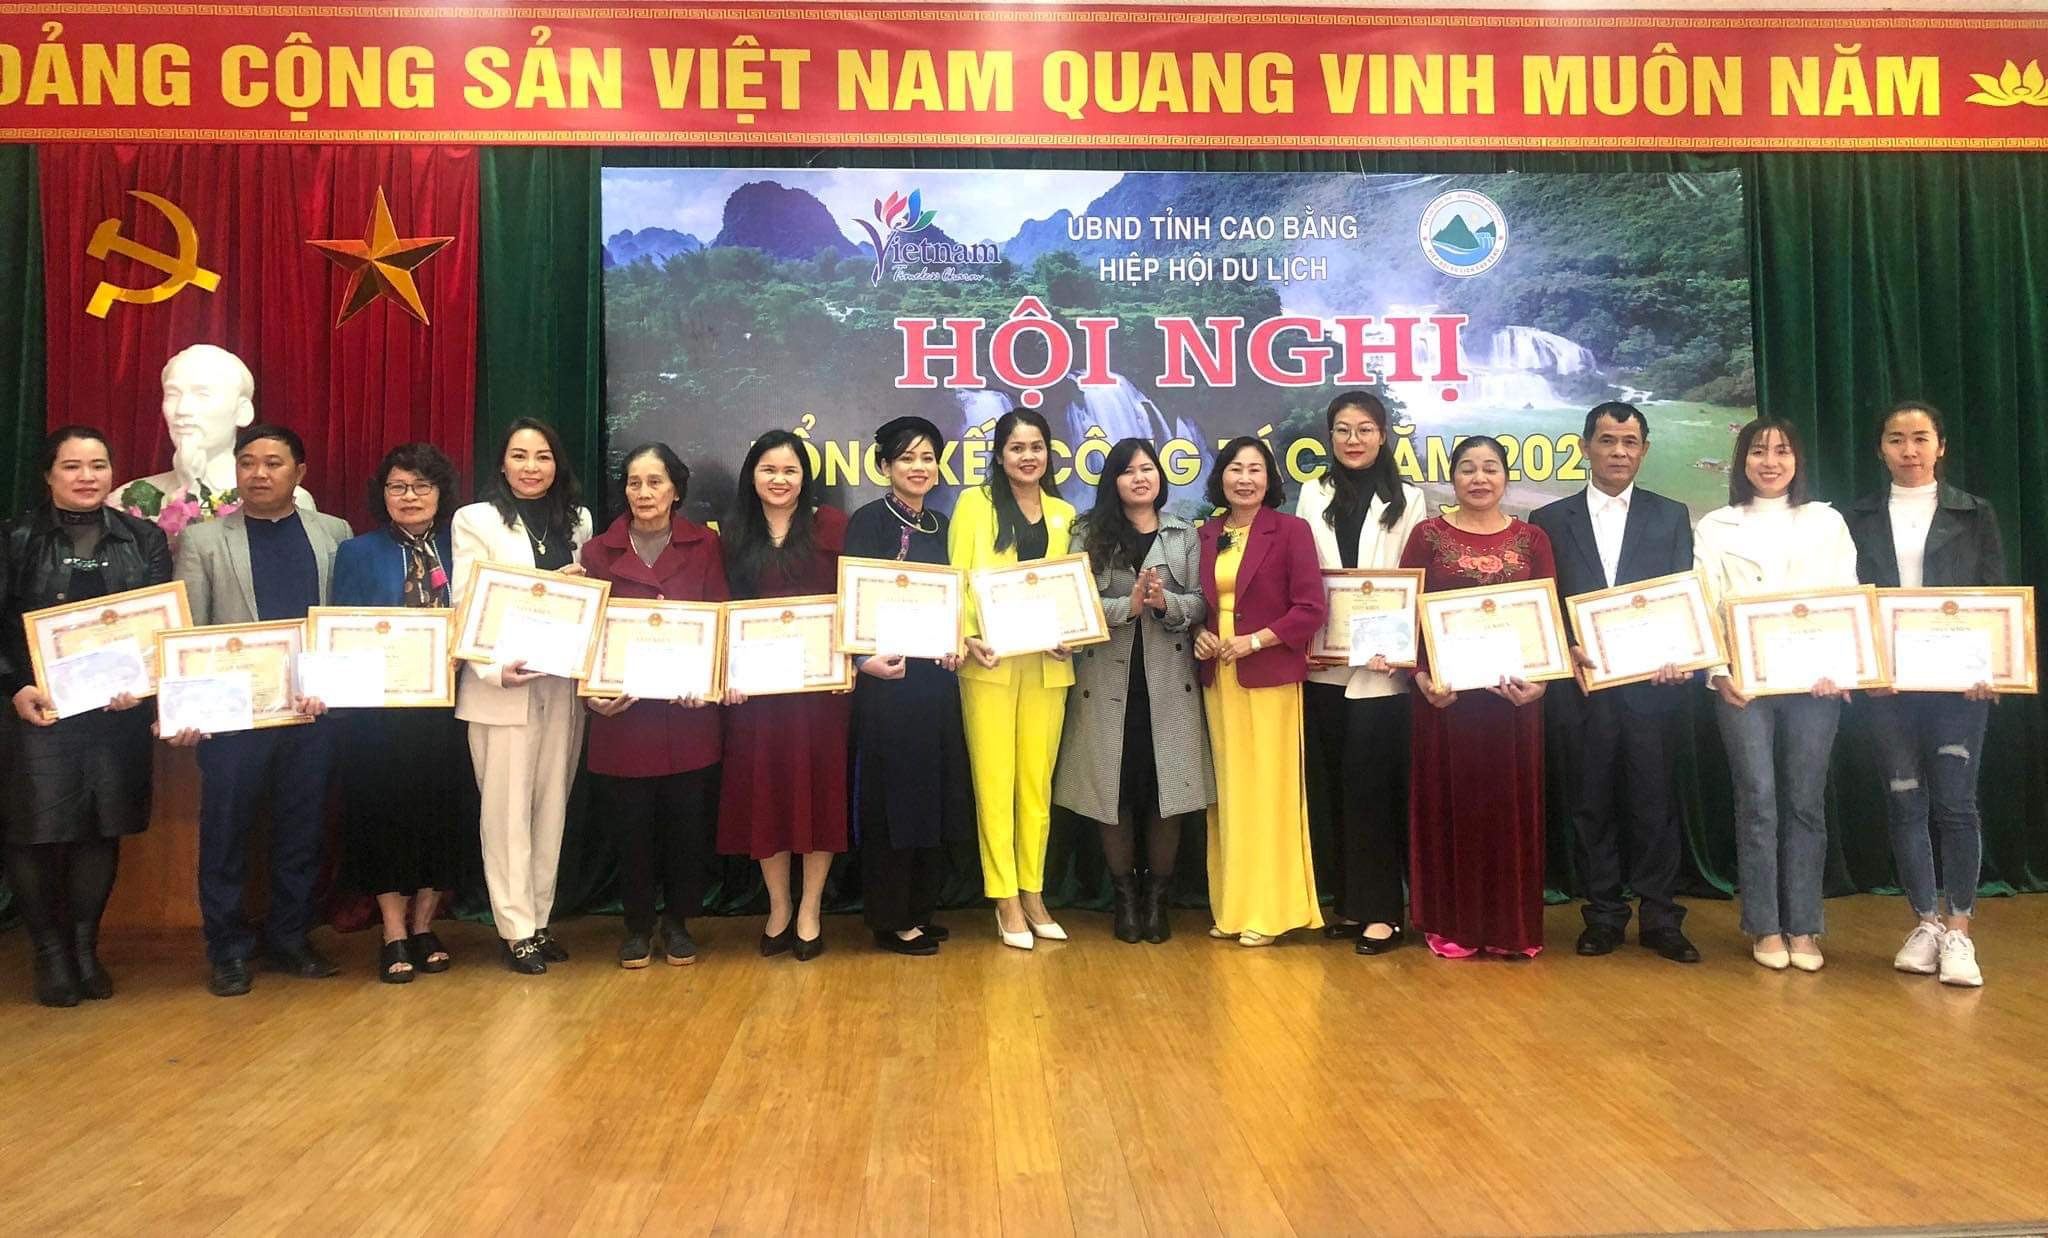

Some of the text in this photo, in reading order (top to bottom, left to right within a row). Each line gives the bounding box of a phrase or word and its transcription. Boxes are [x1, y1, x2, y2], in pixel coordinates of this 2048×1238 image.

[221, 31, 435, 122] CỘNG
[463, 25, 623, 111] SẢN
[649, 35, 811, 124] VIỆT
[837, 48, 1016, 112] NAM
[1041, 49, 1294, 121] QUANG
[1319, 52, 1495, 115] VINH
[1522, 42, 1743, 116] MUÔN
[1770, 42, 1941, 117] NĂM
[851, 218, 1002, 288] Vietnam
[1067, 205, 1359, 241] UBND TỈNH CAO BẰNG
[1099, 251, 1328, 287] HIỆP HỘI DU LỊCH
[894, 295, 1469, 408] HỘI NGHỊ
[1049, 425, 1202, 487] CÔG
[1495, 432, 1594, 482] 202
